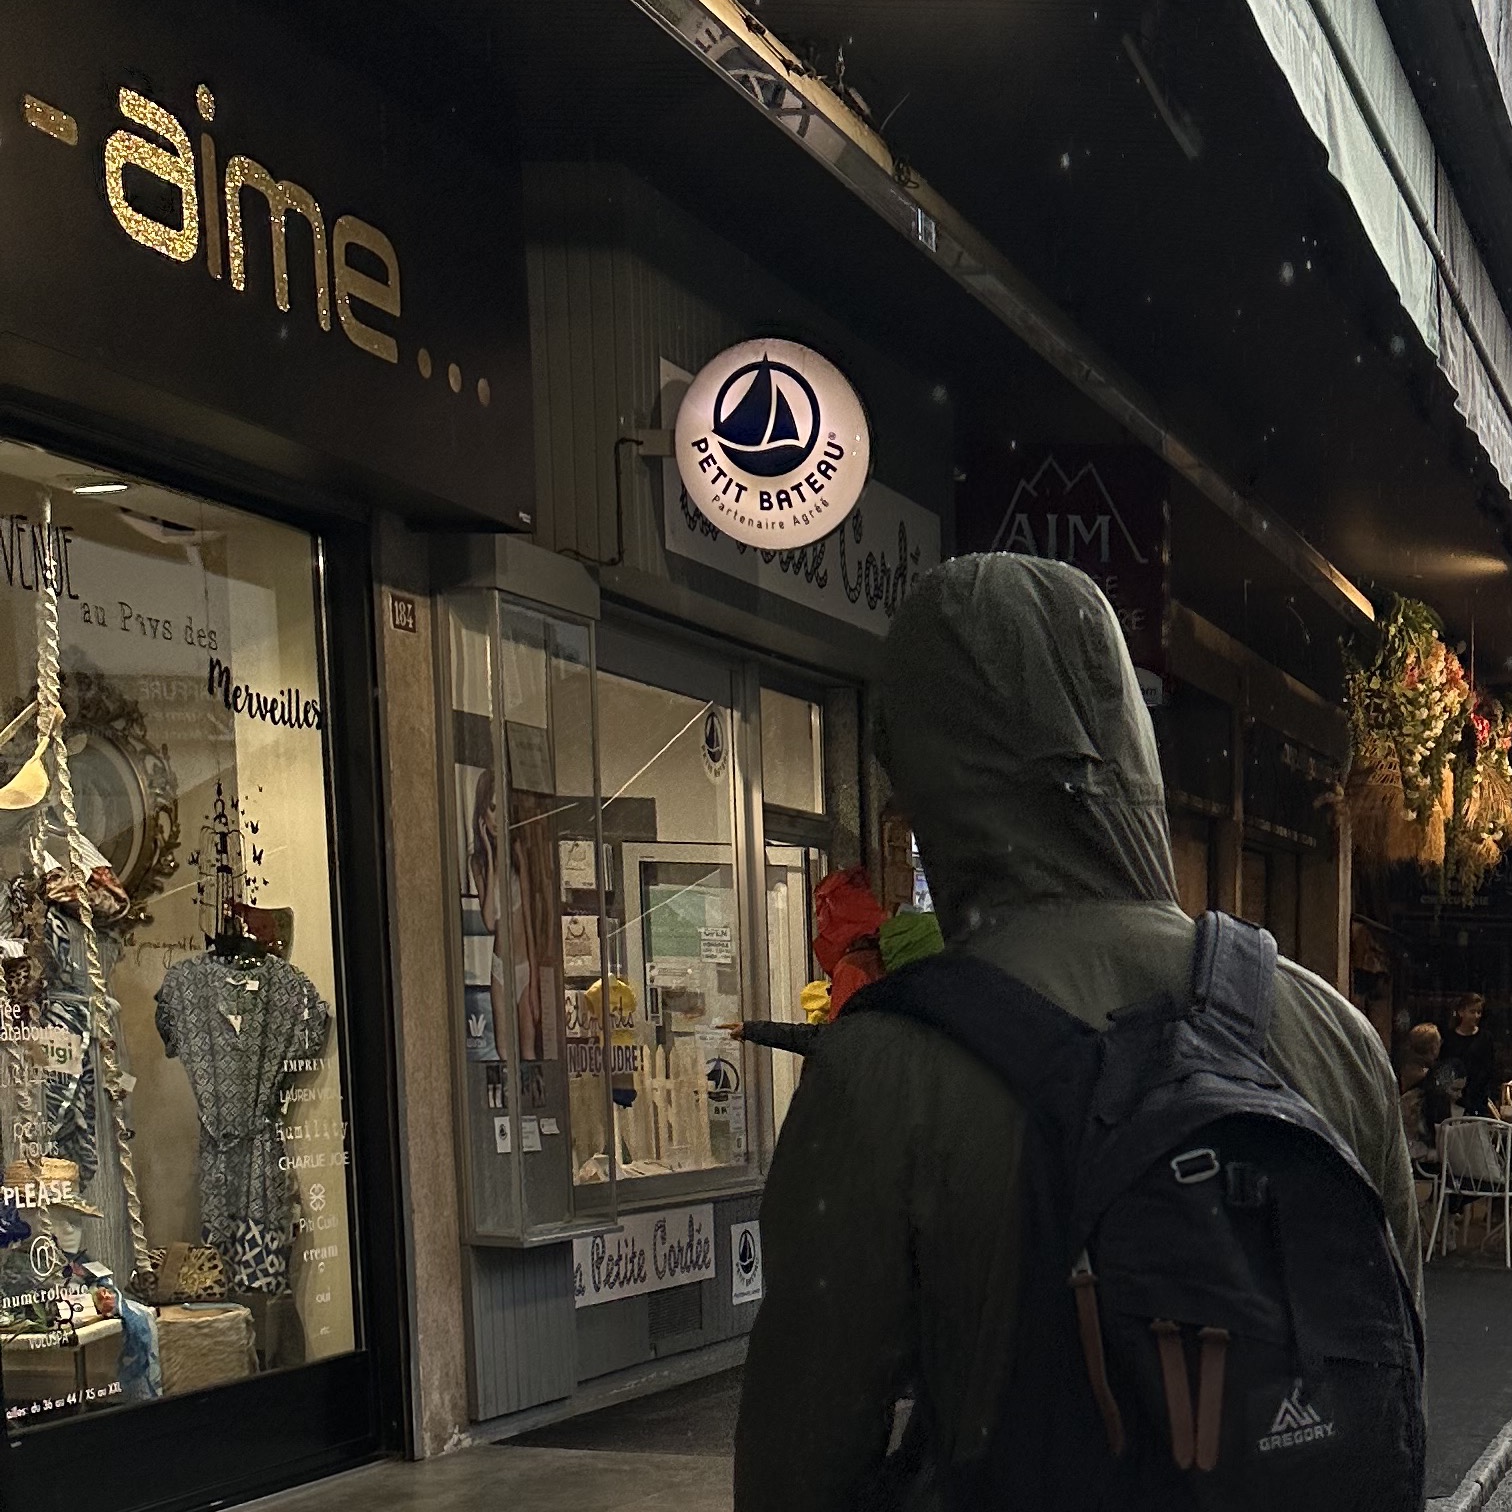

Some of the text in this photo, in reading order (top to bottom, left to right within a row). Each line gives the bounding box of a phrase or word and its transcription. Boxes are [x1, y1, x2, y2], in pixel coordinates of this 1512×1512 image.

[691, 437, 845, 511] PETIT BATEAU
[711, 494, 785, 530] Partenaire
[792, 496, 830, 526] Agréé
[1005, 512, 1112, 564] AIM
[80, 602, 219, 651] au Pays des
[394, 600, 414, 629] 184
[207, 655, 322, 731] Merveilles
[303, 1245, 339, 1262] cream
[590, 1233, 647, 1293] Petite
[653, 1213, 714, 1281] Cordée
[1258, 1421, 1336, 1451] GREGORY
